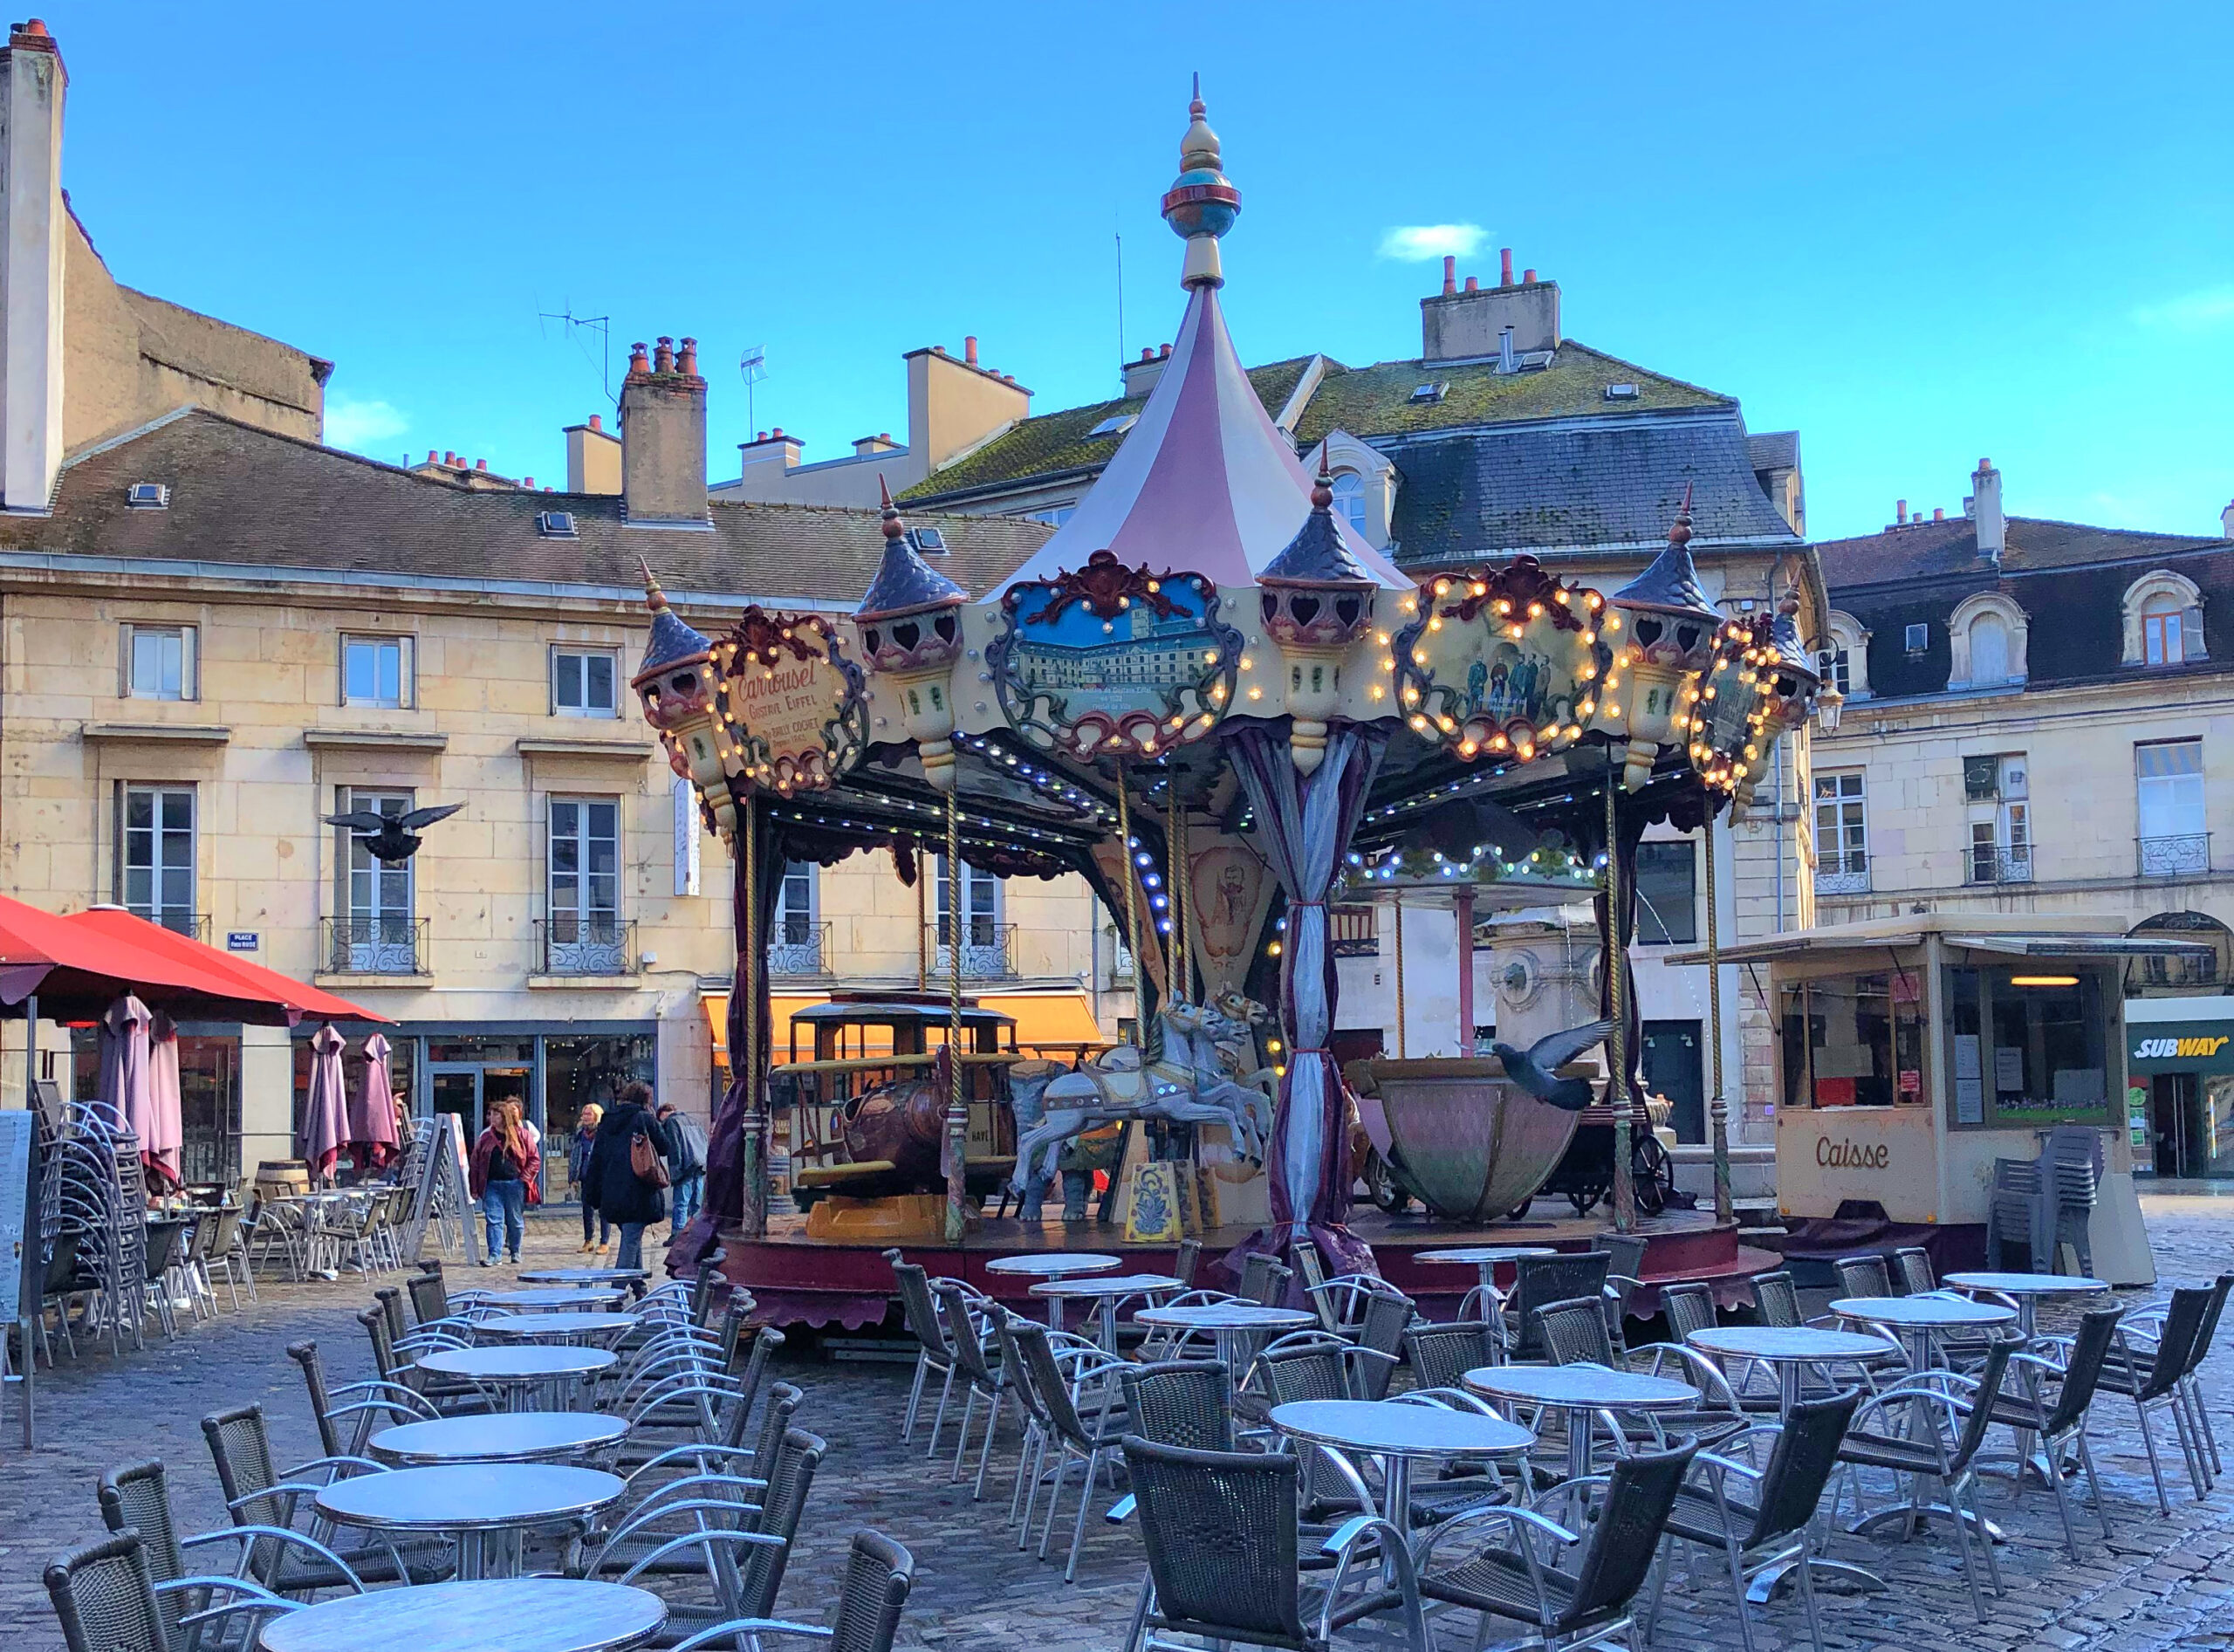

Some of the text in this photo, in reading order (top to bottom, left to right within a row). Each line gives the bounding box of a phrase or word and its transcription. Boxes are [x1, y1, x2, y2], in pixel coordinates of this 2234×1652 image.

[738, 661, 816, 702] Carrousel
[749, 695, 818, 719] GUSTAVE EIFFEL
[2134, 1036, 2230, 1059] SUBWAY
[1816, 1136, 1890, 1169] Caisse
